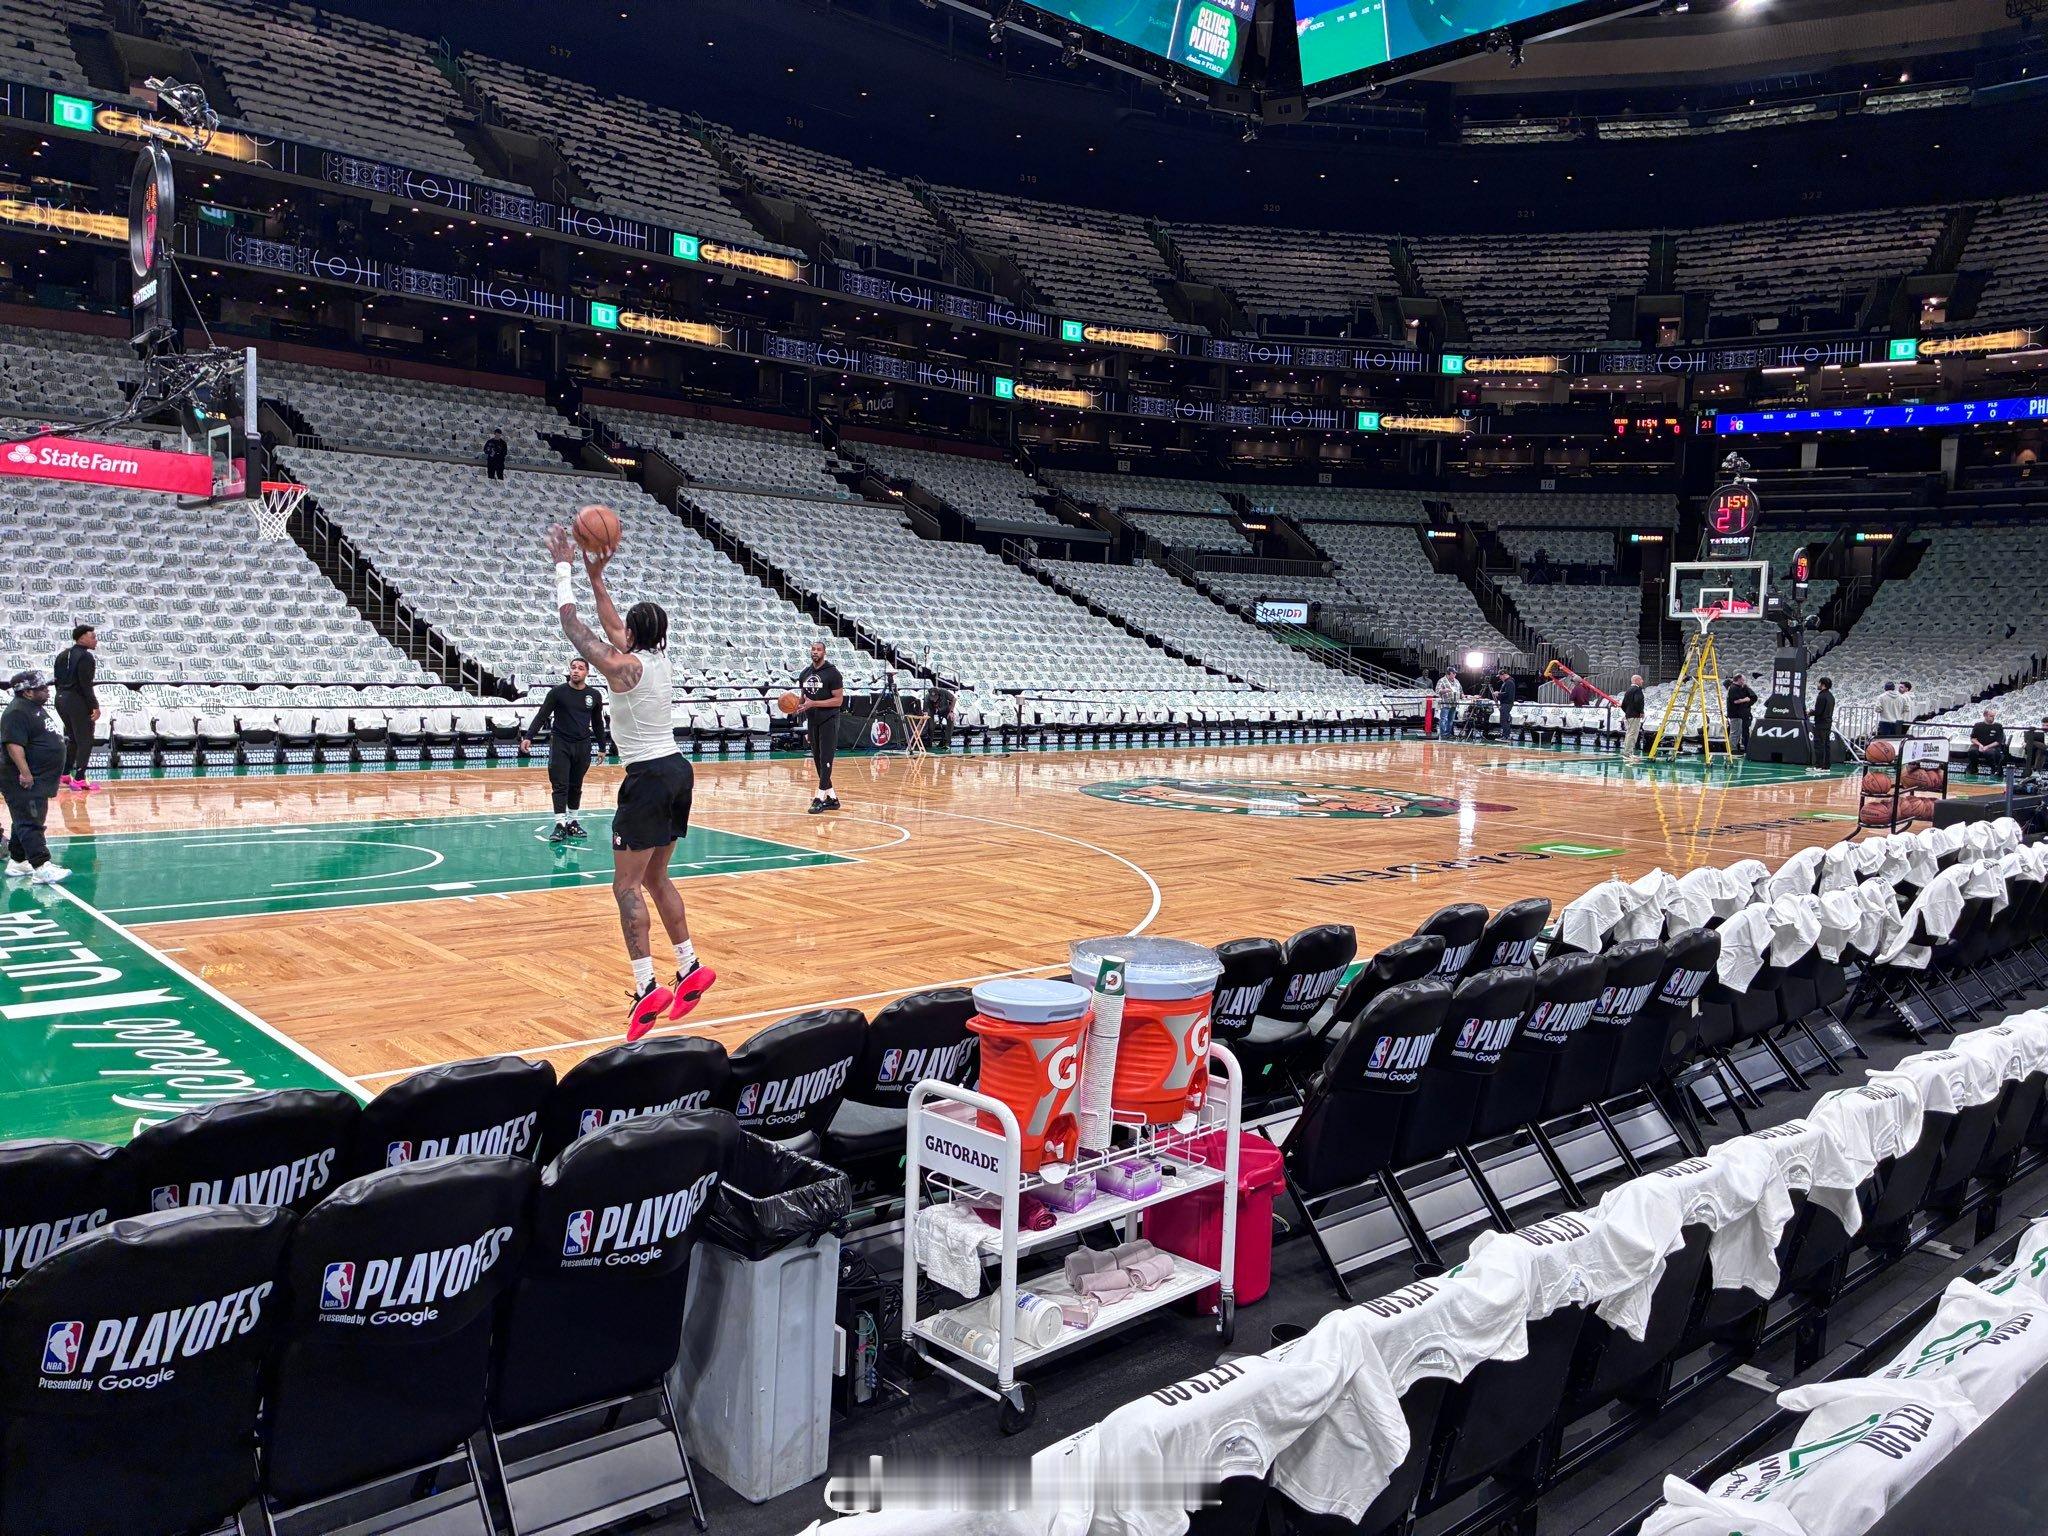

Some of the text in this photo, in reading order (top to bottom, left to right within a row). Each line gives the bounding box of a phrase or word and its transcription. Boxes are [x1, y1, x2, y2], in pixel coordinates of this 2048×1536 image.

[1198, 6, 1231, 37] CELTICS
[1189, 28, 1231, 60] PLAYOFFS
[866, 397, 894, 411] nuca
[1966, 411, 1973, 420] 7
[1989, 409, 1997, 418] 0
[1636, 419, 1658, 427] 11:54
[1701, 420, 1712, 429] 21
[39, 447, 139, 475] State Farm
[1720, 495, 1748, 509] 11:54
[1717, 507, 1745, 529] 21
[1720, 536, 1751, 545] TISSOT
[116, 656, 139, 667] CELTICS
[204, 671, 227, 682] CELTICS
[1212, 977, 1274, 1016] PLAYO
[1215, 1015, 1248, 1029] Google
[1471, 1011, 1526, 1051] PLAYO
[1191, 1015, 1209, 1057] G
[1384, 1026, 1441, 1069] PLAYO
[1544, 1032, 1568, 1044] Google
[1048, 1043, 1077, 1090] G
[1475, 1051, 1501, 1064] Google
[757, 1055, 854, 1115] PLAYOFFS
[1388, 1070, 1418, 1083] Google
[766, 1110, 806, 1126] Google
[925, 1134, 1000, 1174] GATORADE
[1659, 1156, 1713, 1179] LET'S GO
[593, 1171, 718, 1253] PLAYOFFS
[0, 1208, 108, 1274] YOFFS
[1514, 1214, 1590, 1246] LET'S GO
[355, 1226, 514, 1310] PLAYOFFS
[560, 1258, 596, 1268] Presented
[605, 1246, 663, 1267] Google
[324, 1299, 339, 1308] NBA
[1362, 1281, 1439, 1319] LET'S GO
[81, 1280, 274, 1374] PLAYOFFS
[318, 1306, 439, 1326] Presented by Google
[46, 1361, 63, 1371] NBA
[38, 1367, 176, 1391] Presented by Google
[1150, 1362, 1246, 1407] LET'S GO
[1858, 1403, 1935, 1460] LET'S GO
